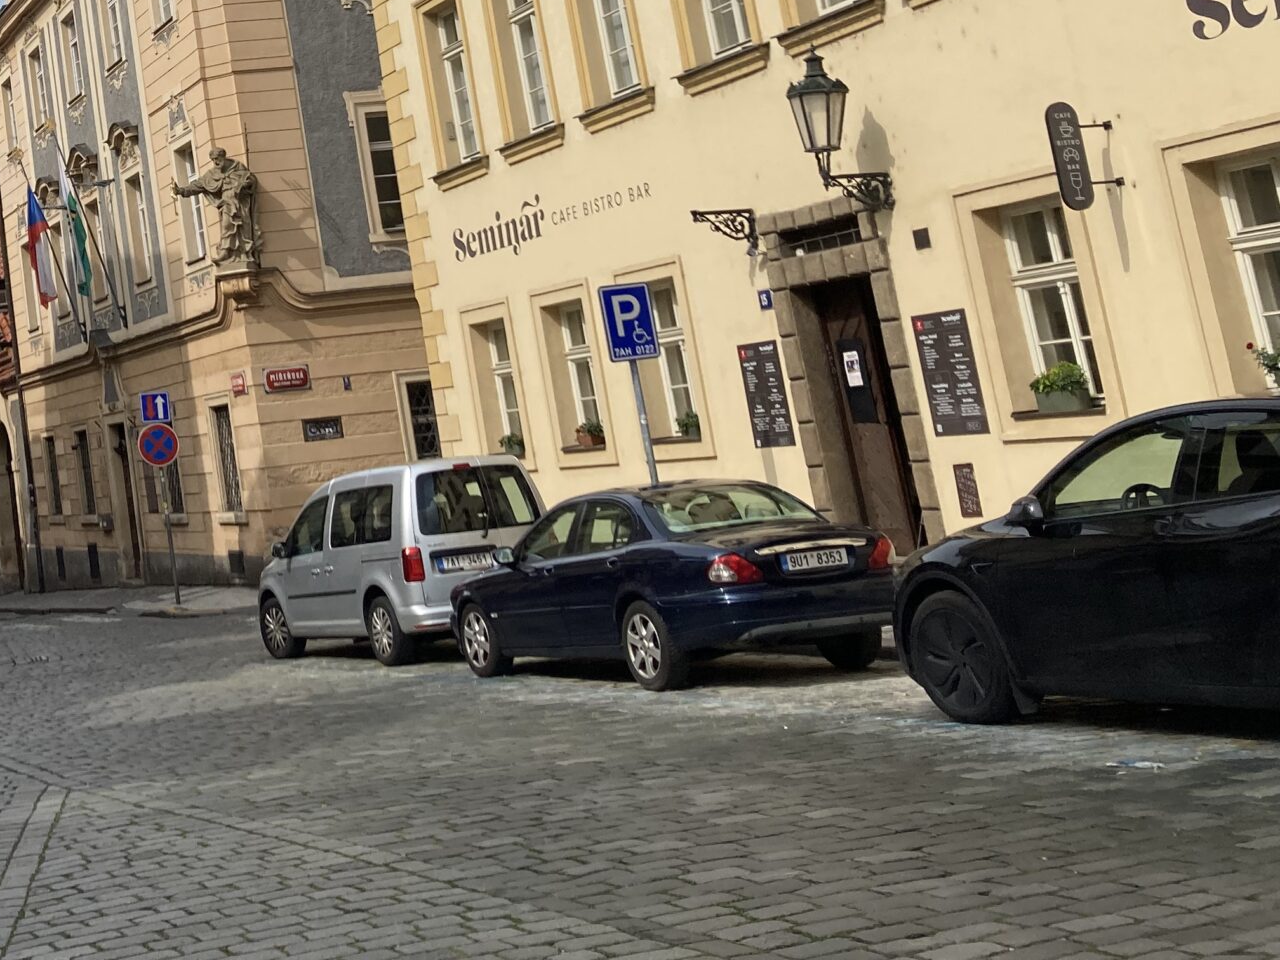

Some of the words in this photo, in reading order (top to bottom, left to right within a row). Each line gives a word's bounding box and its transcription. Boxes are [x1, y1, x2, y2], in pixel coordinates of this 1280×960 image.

[551, 205, 579, 226] CAFE
[582, 191, 624, 217] BISTRO
[627, 182, 652, 203] BAR
[610, 294, 641, 338] P
[789, 554, 810, 568] 9U1
[816, 550, 843, 565] 8353
